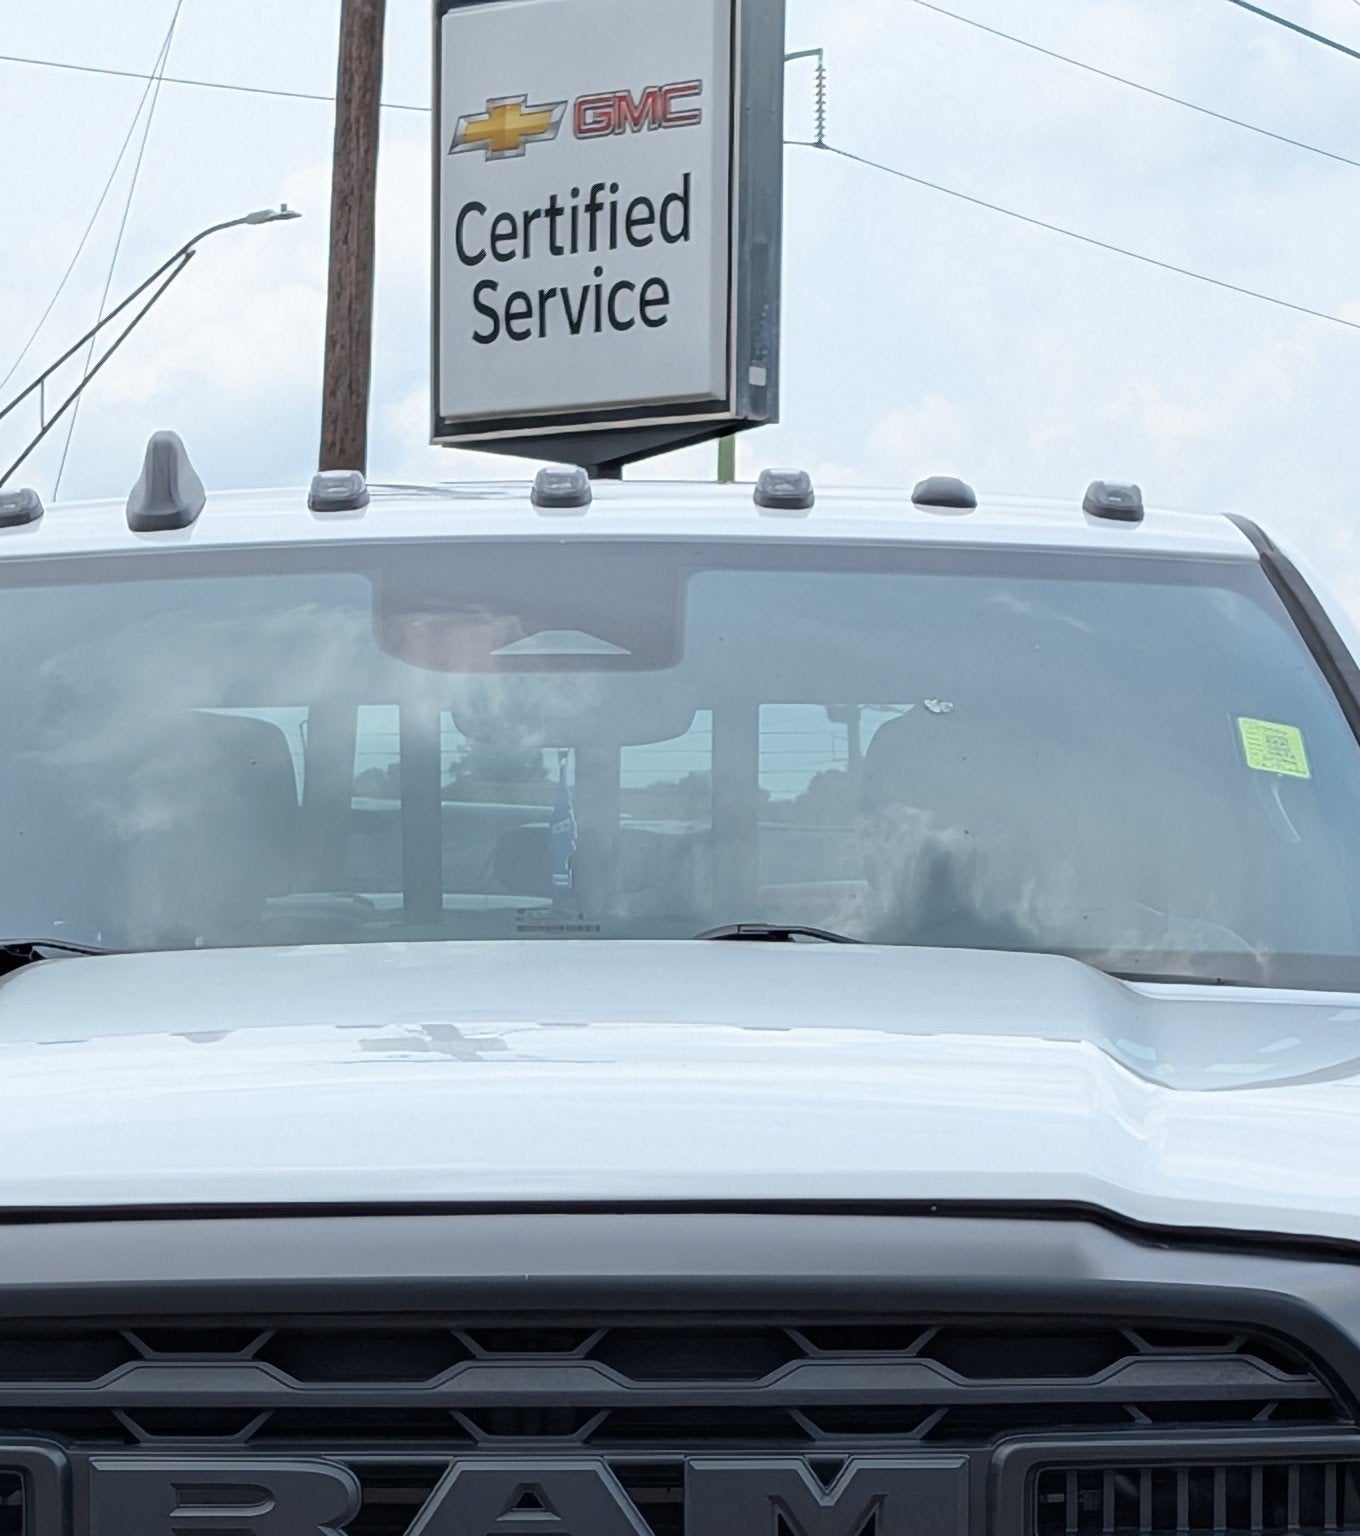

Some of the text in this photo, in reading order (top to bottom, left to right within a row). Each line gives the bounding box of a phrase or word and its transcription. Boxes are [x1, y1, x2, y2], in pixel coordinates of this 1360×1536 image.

[574, 79, 703, 141] GMC
[455, 172, 692, 267] Certified
[472, 265, 671, 345] Service
